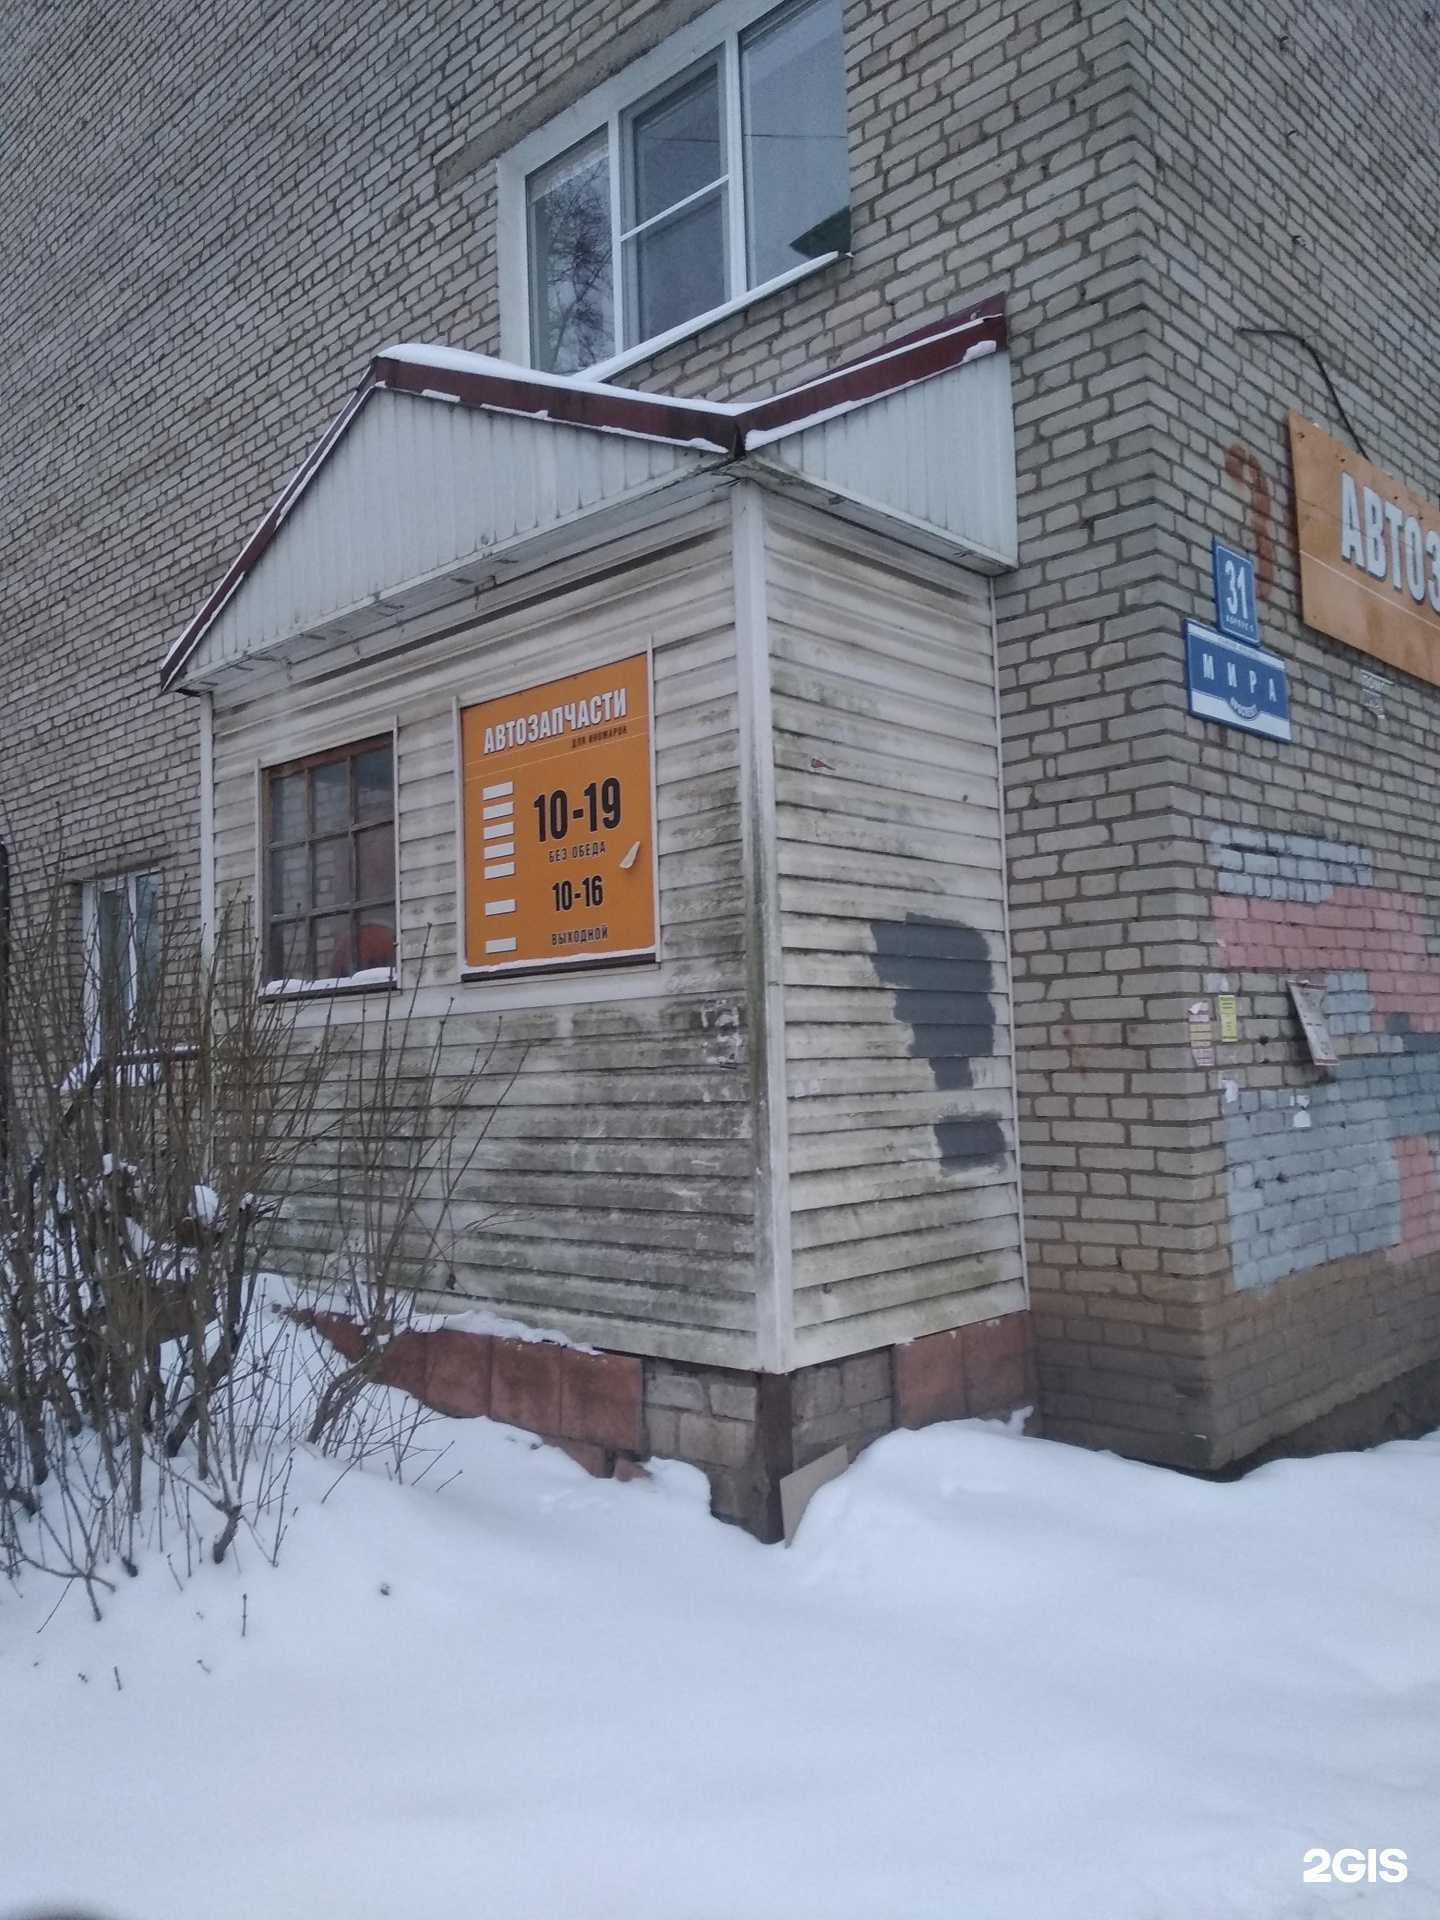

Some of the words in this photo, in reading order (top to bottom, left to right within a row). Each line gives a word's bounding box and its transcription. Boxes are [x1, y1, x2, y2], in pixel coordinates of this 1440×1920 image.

[1341, 472, 1440, 614] АВТОЗ
[1224, 560, 1249, 619] 31
[1202, 653, 1277, 702] МИРА
[484, 688, 627, 755] АВТОЗАПЧАСТИ
[533, 777, 621, 842] 10-19
[549, 848, 567, 863] БЕЗ
[571, 841, 606, 858] ОБЕДА
[552, 875, 603, 911] 10-16
[551, 923, 608, 946] ВЫХОДНОЙ
